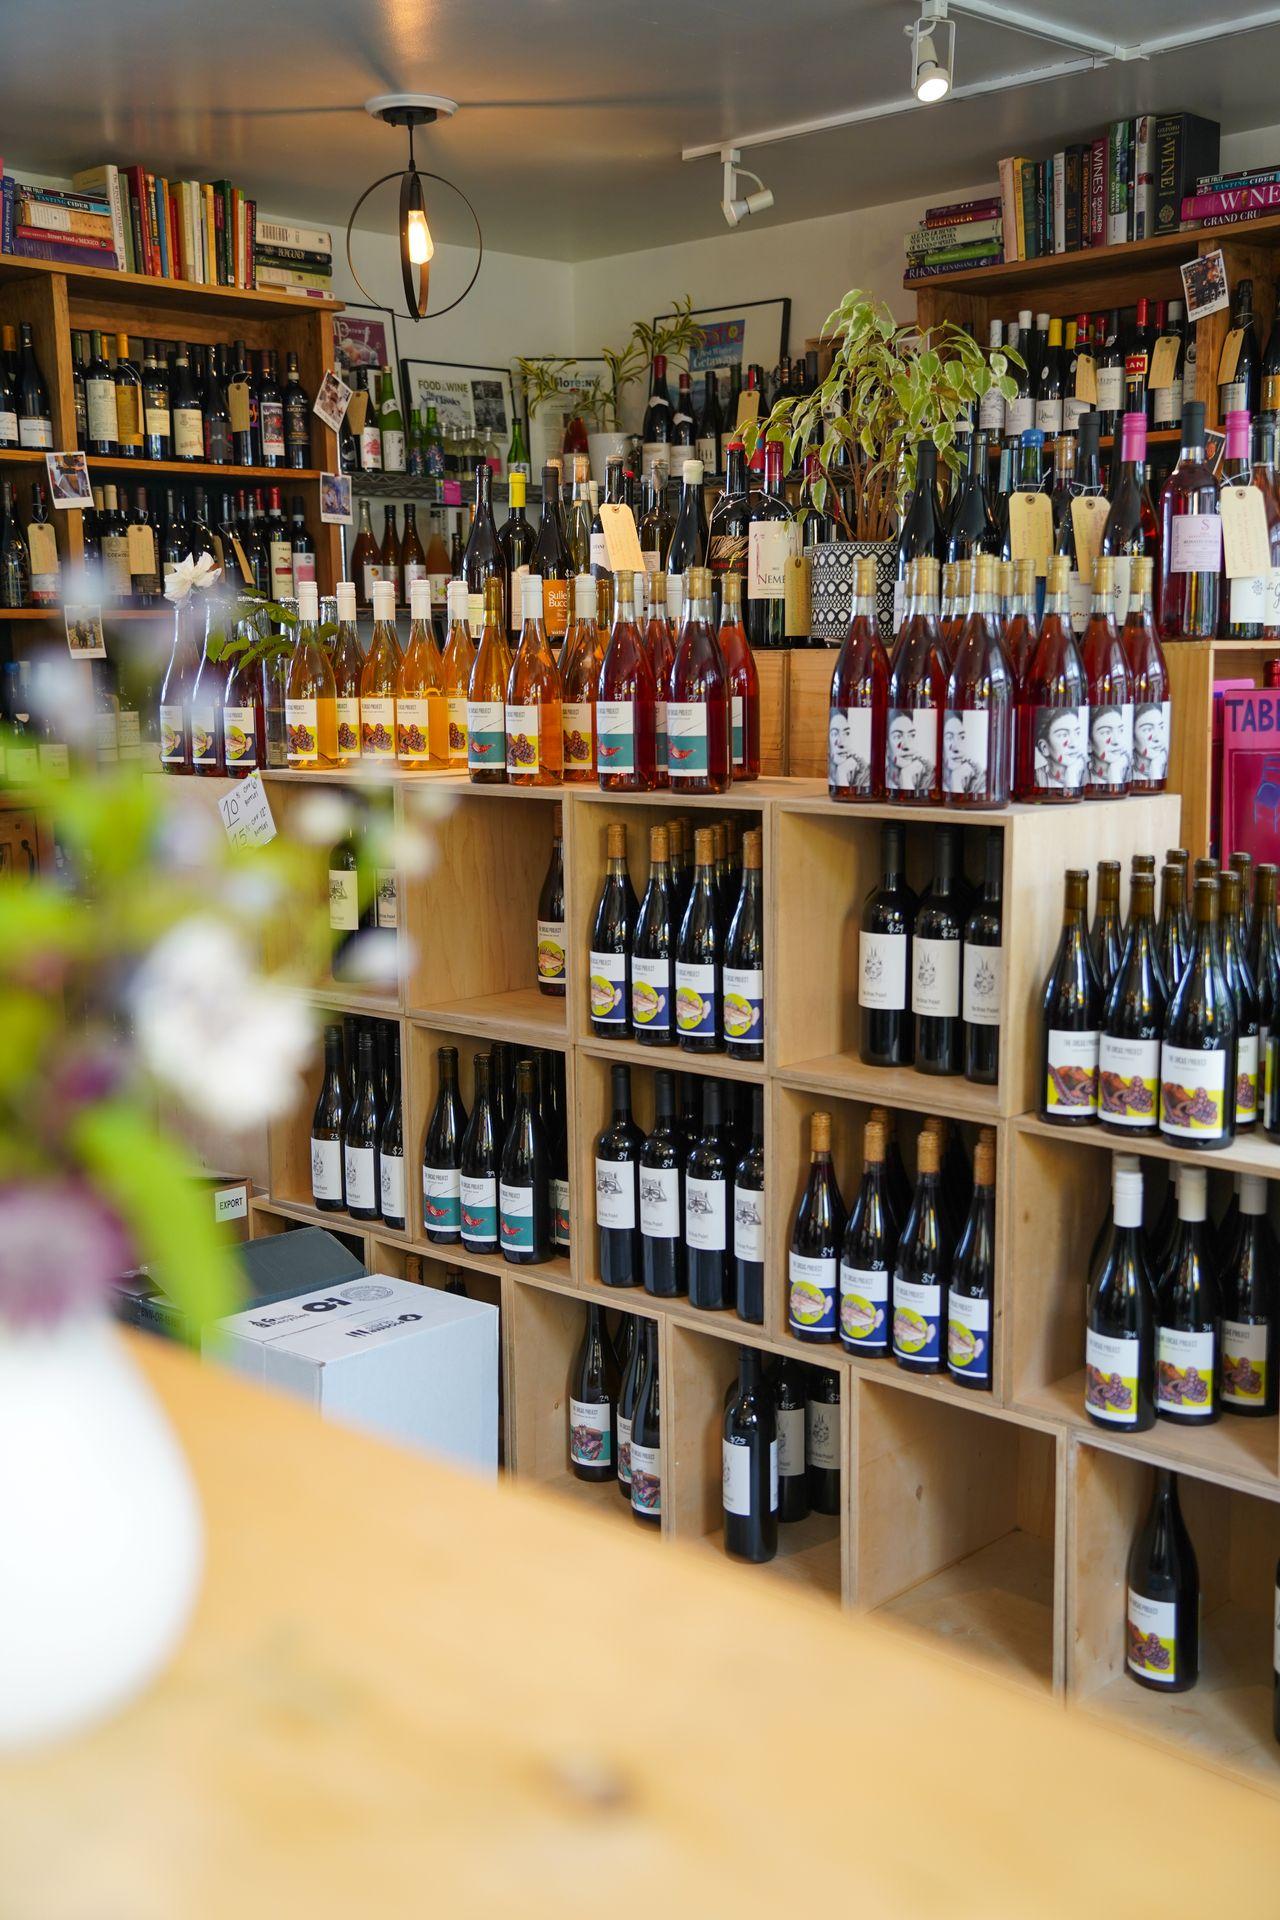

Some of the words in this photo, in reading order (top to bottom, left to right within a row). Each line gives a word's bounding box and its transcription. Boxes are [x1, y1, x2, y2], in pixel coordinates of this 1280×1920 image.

[1160, 140, 1175, 188] WINE
[1092, 148, 1103, 194] WINES
[1214, 180, 1248, 190] TASTING
[1249, 175, 1275, 184] CIDER
[36, 193, 66, 204] TASTING
[66, 200, 89, 210] CIDER
[1204, 210, 1238, 228] GRAND
[1239, 209, 1260, 220] CRU
[63, 234, 74, 242] Food
[78, 238, 99, 246] MEXICO
[418, 380, 440, 390] FOOD
[446, 383, 468, 393] WINE
[549, 600, 567, 608] Bucc
[224, 798, 240, 829] 10
[662, 1159, 673, 1169] 34
[219, 1196, 243, 1211] EXPORT
[821, 1247, 834, 1258] 34
[871, 1260, 884, 1270] 34
[921, 1272, 936, 1285] 34
[970, 1286, 984, 1298] 34
